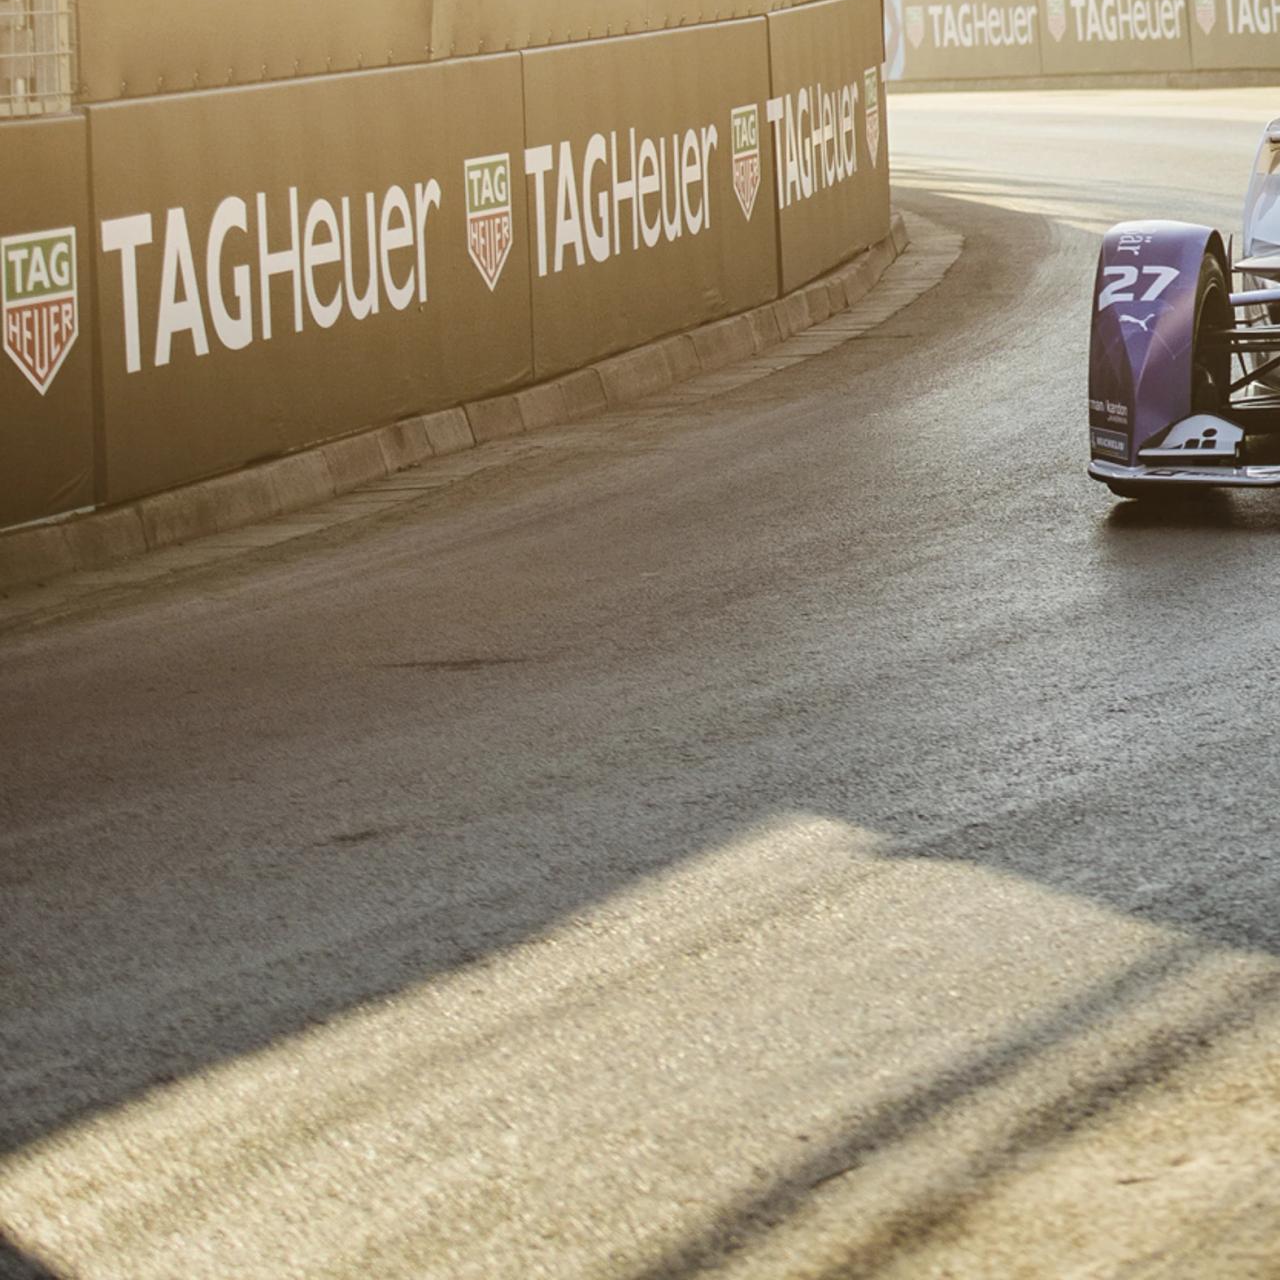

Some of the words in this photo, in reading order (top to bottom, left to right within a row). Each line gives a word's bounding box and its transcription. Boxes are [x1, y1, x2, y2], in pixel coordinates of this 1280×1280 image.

[734, 112, 757, 150] TAG
[469, 166, 507, 208] TAG
[8, 241, 70, 294] TAG
[470, 216, 510, 278] HEUER
[1098, 265, 1180, 312] 27
[8, 302, 73, 380] HEUER
[1096, 436, 1125, 451] MICHELIN
